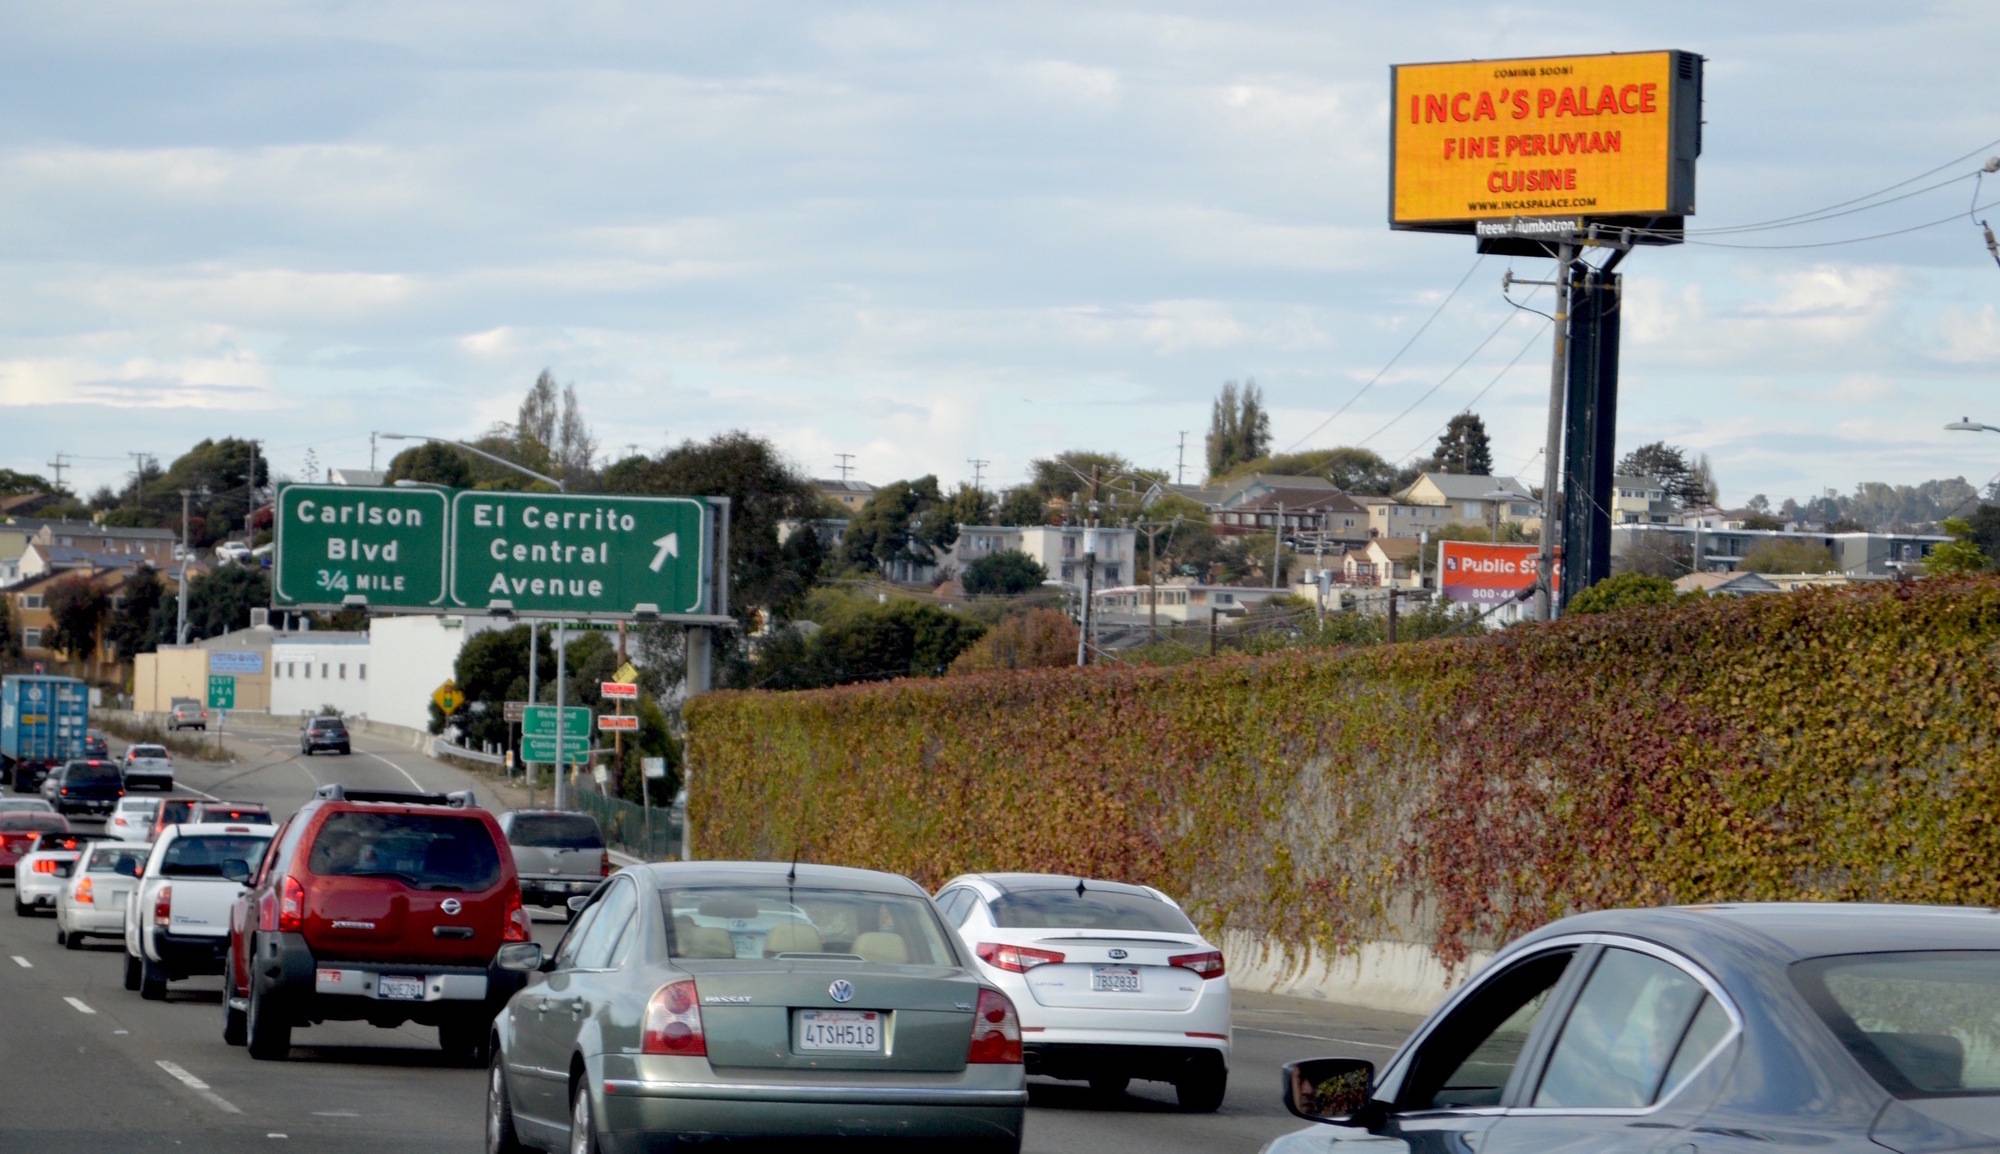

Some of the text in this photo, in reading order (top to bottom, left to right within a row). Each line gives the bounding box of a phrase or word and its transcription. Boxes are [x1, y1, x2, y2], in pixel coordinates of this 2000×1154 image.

[1494, 65, 1573, 79] COMING SOON!
[1410, 82, 1657, 125] INCA'S PALACE
[1443, 130, 1622, 161] FINE PERUVIAN
[1486, 167, 1577, 194] CUISINE
[1468, 197, 1597, 212] WWW.INCASPALACE.COM
[297, 500, 421, 527] Carlson
[473, 504, 636, 532] El Cerrito
[327, 537, 398, 562] Blvd
[489, 538, 608, 564] Central
[1461, 557, 1516, 573] Public
[356, 574, 405, 591] MILE
[488, 572, 604, 597] Avenue
[210, 676, 232, 685] EXIT
[805, 1024, 875, 1045] 4TSH518
